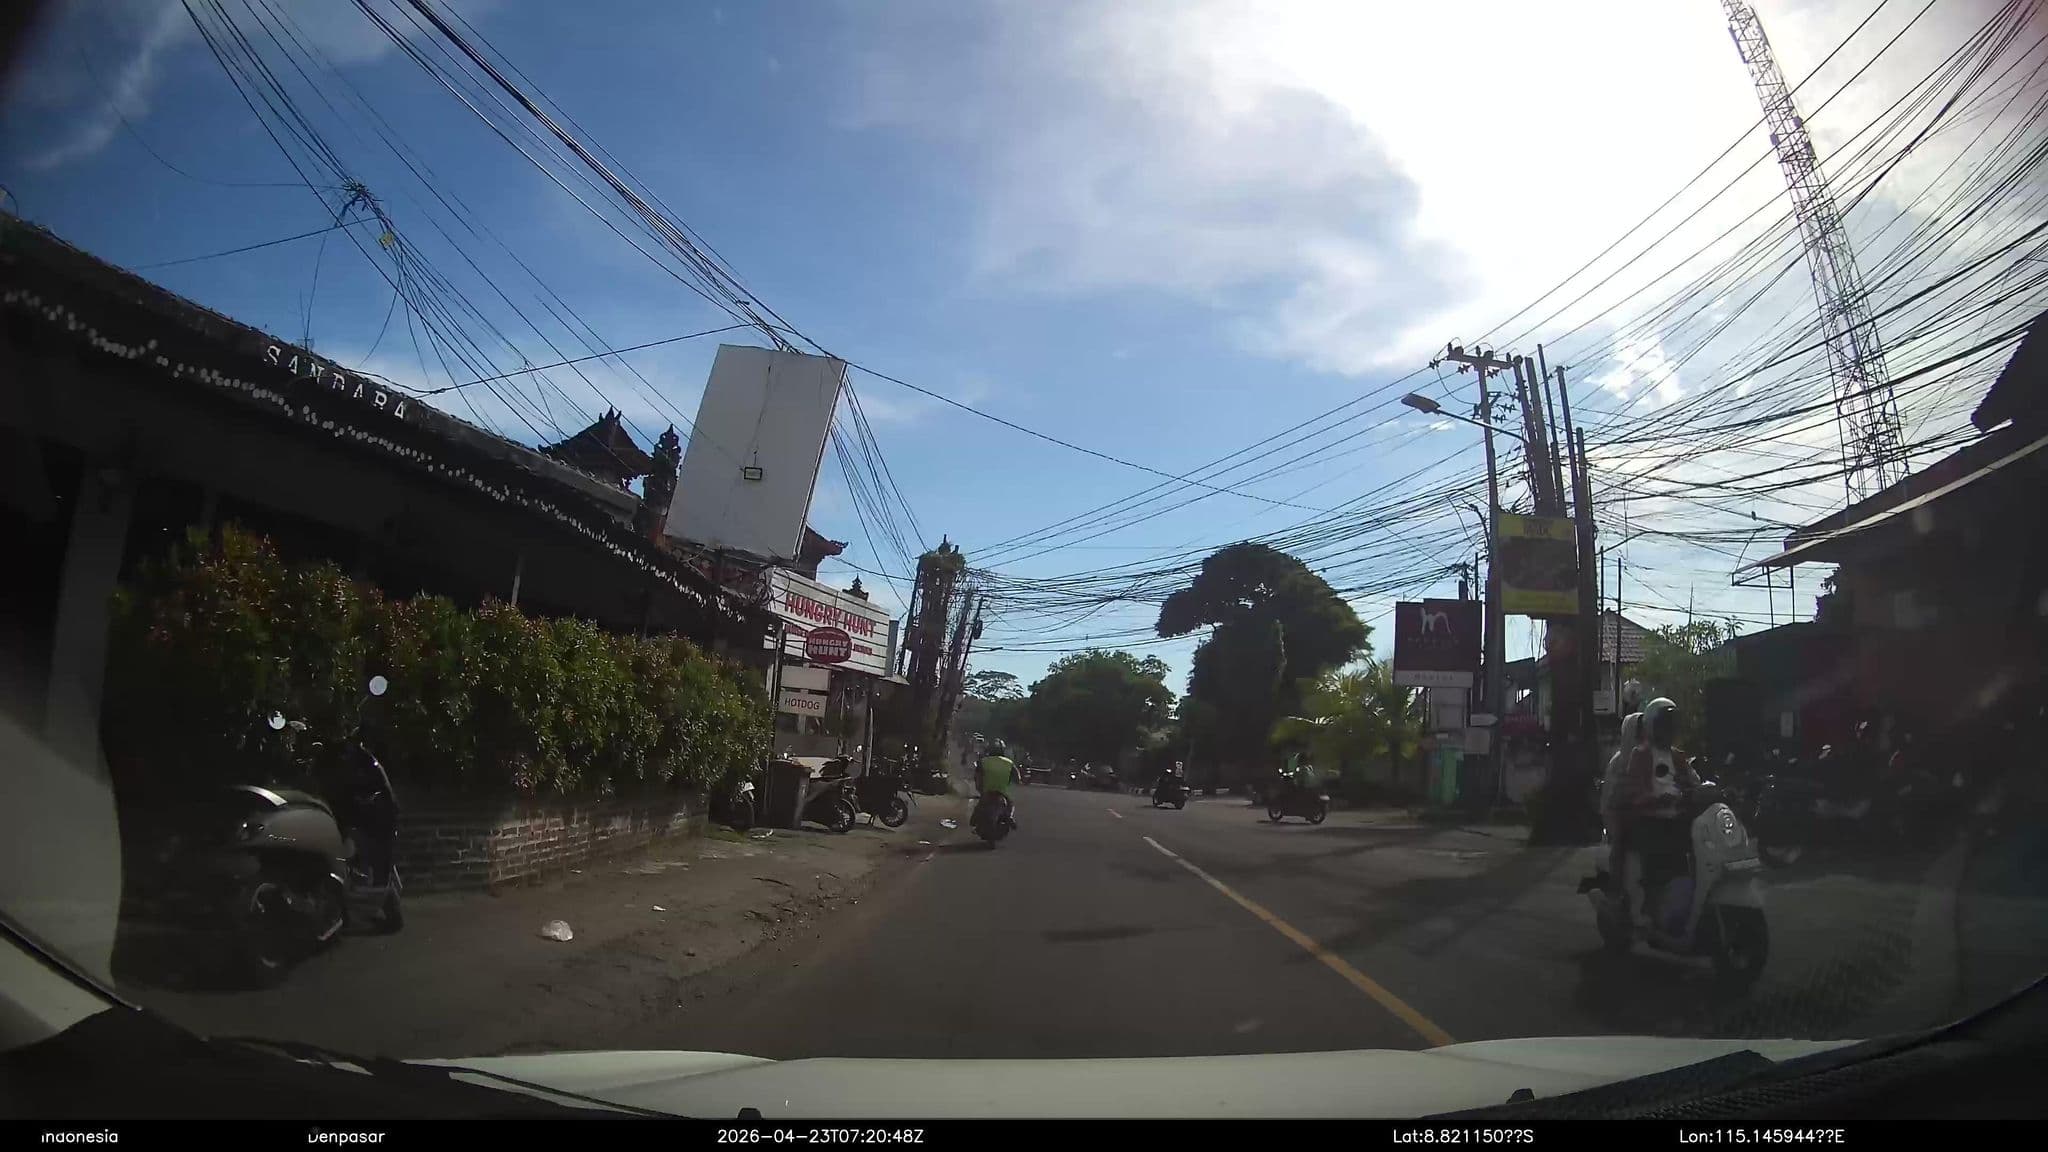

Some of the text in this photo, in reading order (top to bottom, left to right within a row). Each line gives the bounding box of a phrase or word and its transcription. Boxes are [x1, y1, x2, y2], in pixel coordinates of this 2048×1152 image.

[264, 345, 407, 420] SANDARA
[785, 592, 842, 627] HUNGRY
[842, 613, 876, 638] HUNT
[808, 645, 848, 657] HUNT
[784, 698, 820, 710] HOTDOG
